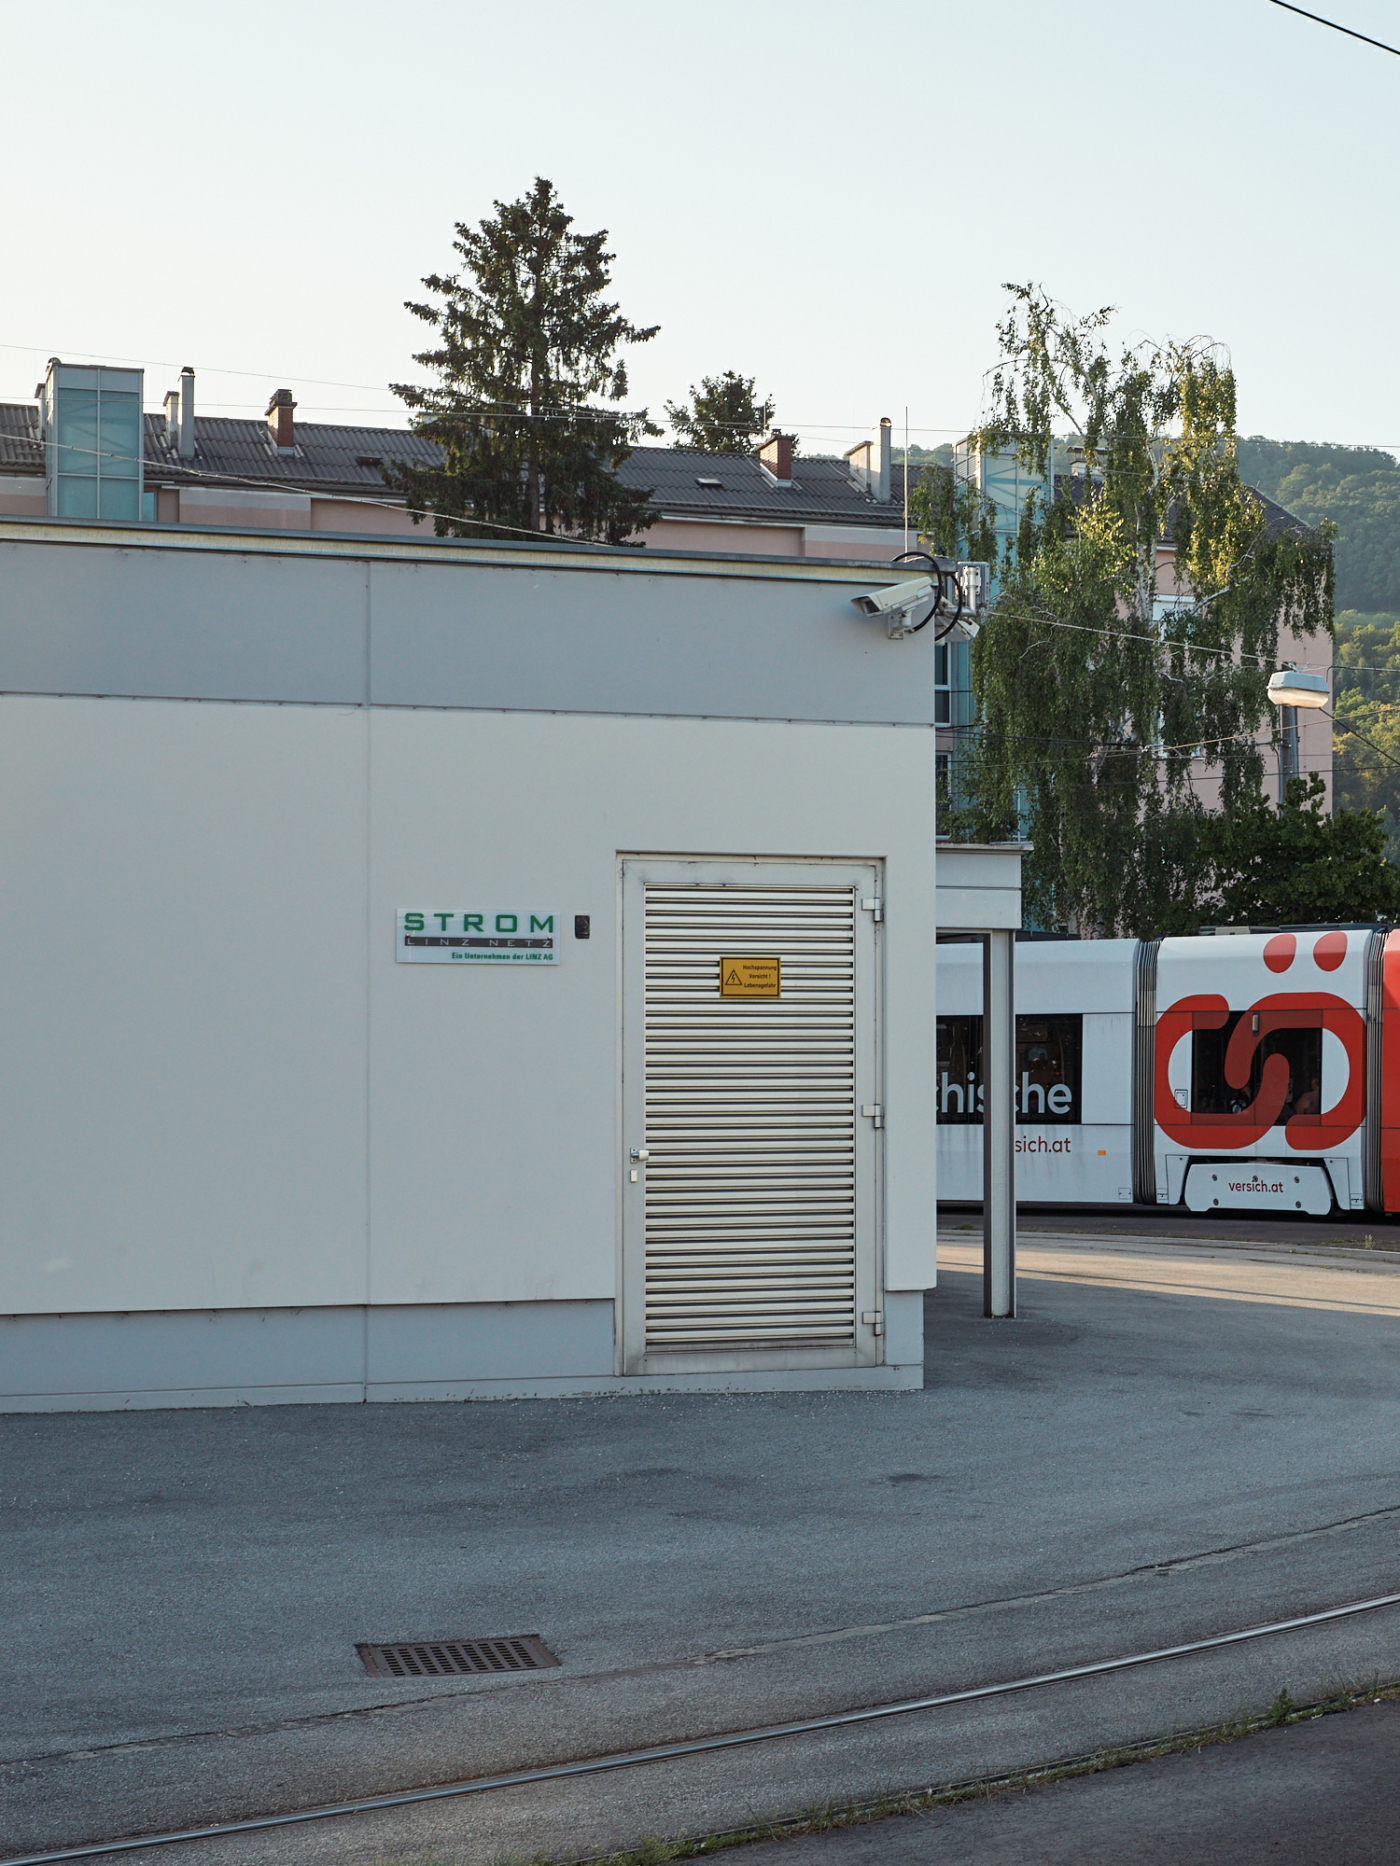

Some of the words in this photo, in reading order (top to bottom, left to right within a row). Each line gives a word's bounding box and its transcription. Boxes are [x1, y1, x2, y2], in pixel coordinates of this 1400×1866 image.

[404, 912, 554, 933] STROM
[407, 938, 470, 946] LINZ
[489, 939, 551, 948] NETZ
[452, 952, 462, 960] Ein
[464, 952, 510, 960] Unternehmen
[512, 952, 524, 960] der
[525, 953, 542, 961] LINZ
[543, 953, 553, 961] AG
[1228, 1180, 1284, 1193] versich.at
